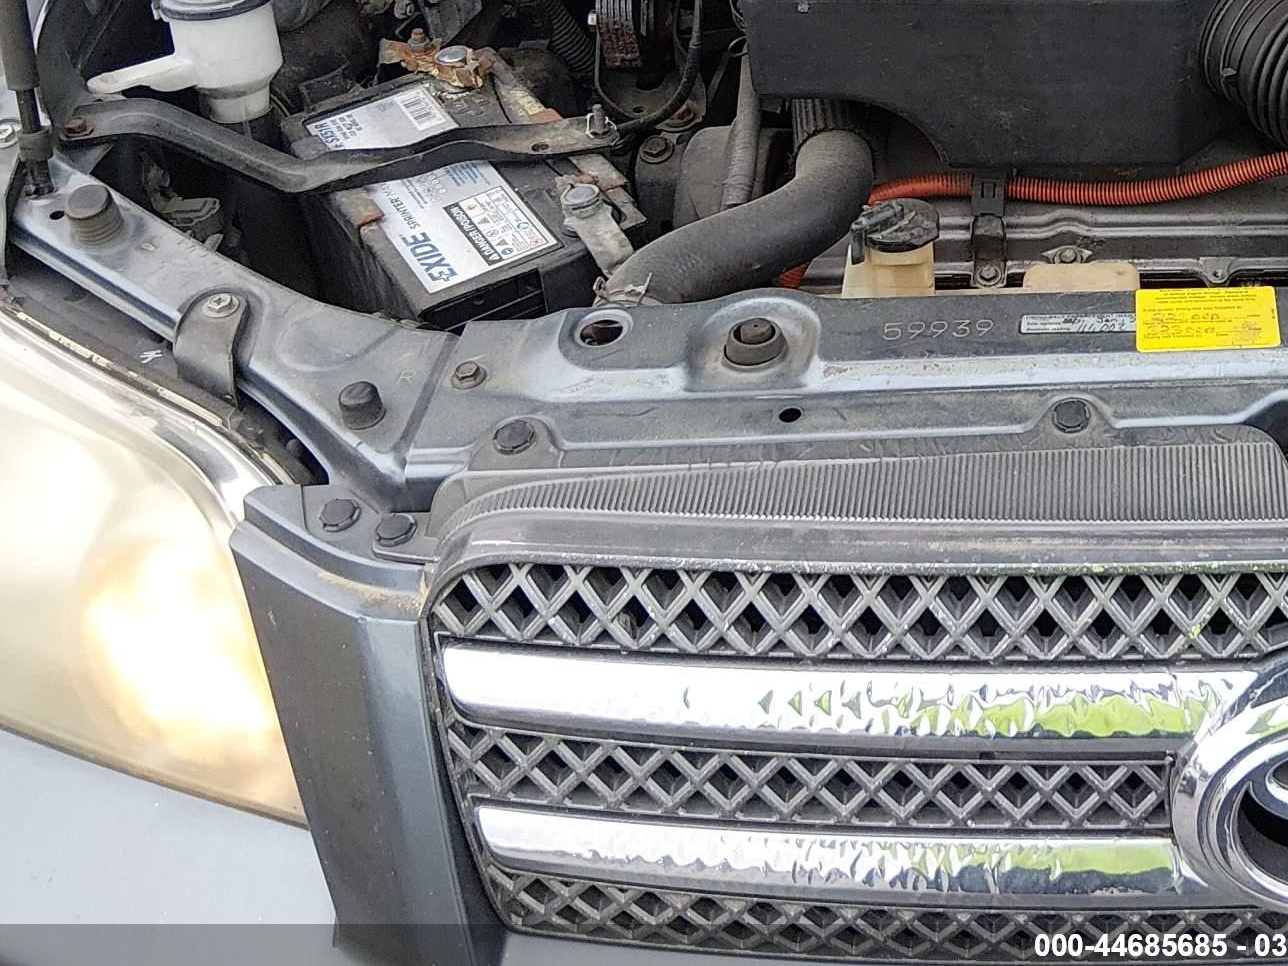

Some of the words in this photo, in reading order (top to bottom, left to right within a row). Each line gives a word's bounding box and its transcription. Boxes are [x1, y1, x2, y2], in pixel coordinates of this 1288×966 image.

[389, 195, 421, 230] SPRINTER
[400, 231, 458, 283] EXIDE
[882, 319, 994, 341] 59939
